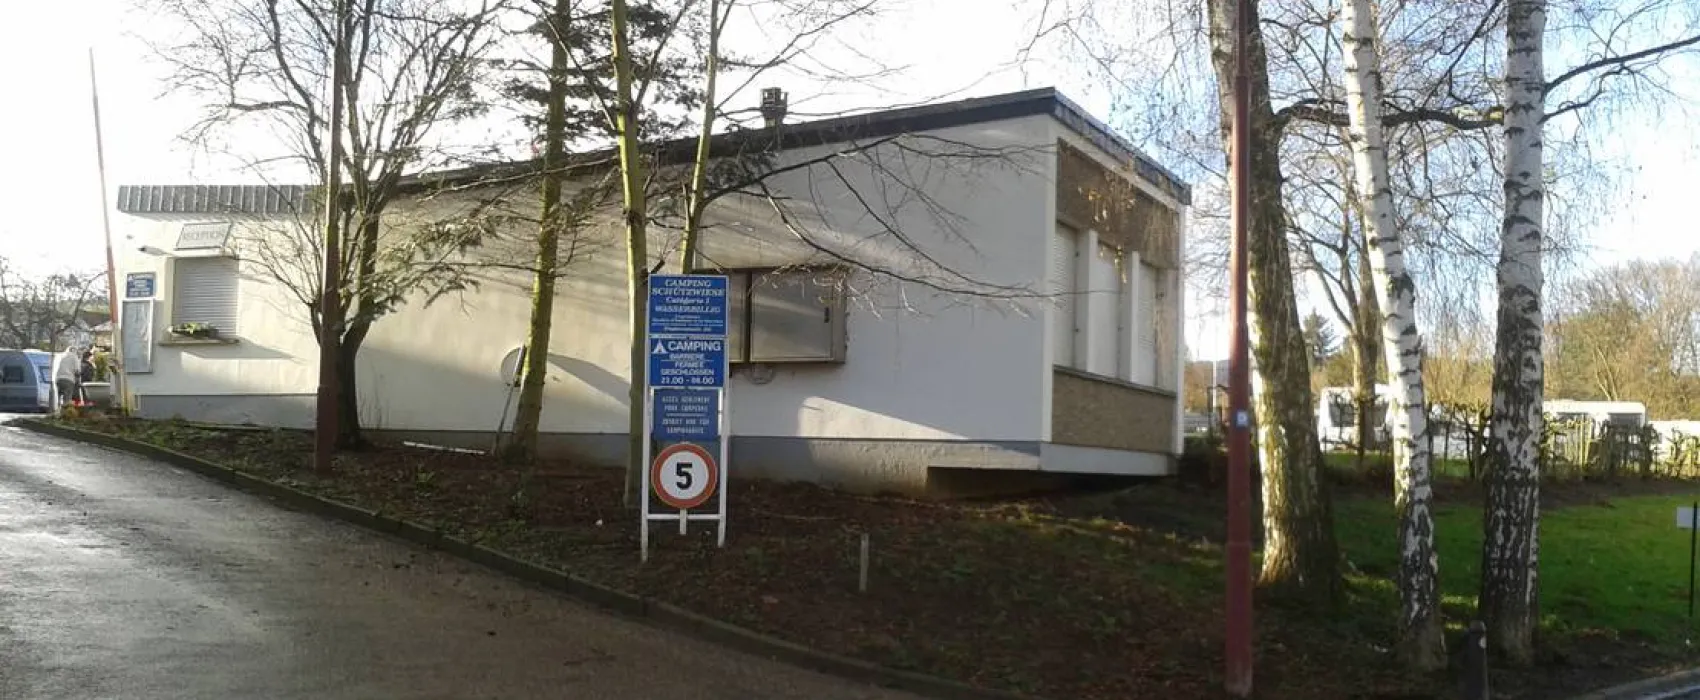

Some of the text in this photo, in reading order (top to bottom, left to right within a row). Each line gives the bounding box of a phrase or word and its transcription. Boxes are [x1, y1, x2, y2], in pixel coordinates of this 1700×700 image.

[665, 279, 712, 287] CAMPING
[668, 340, 721, 352] CAMPING
[676, 462, 692, 490] 5
